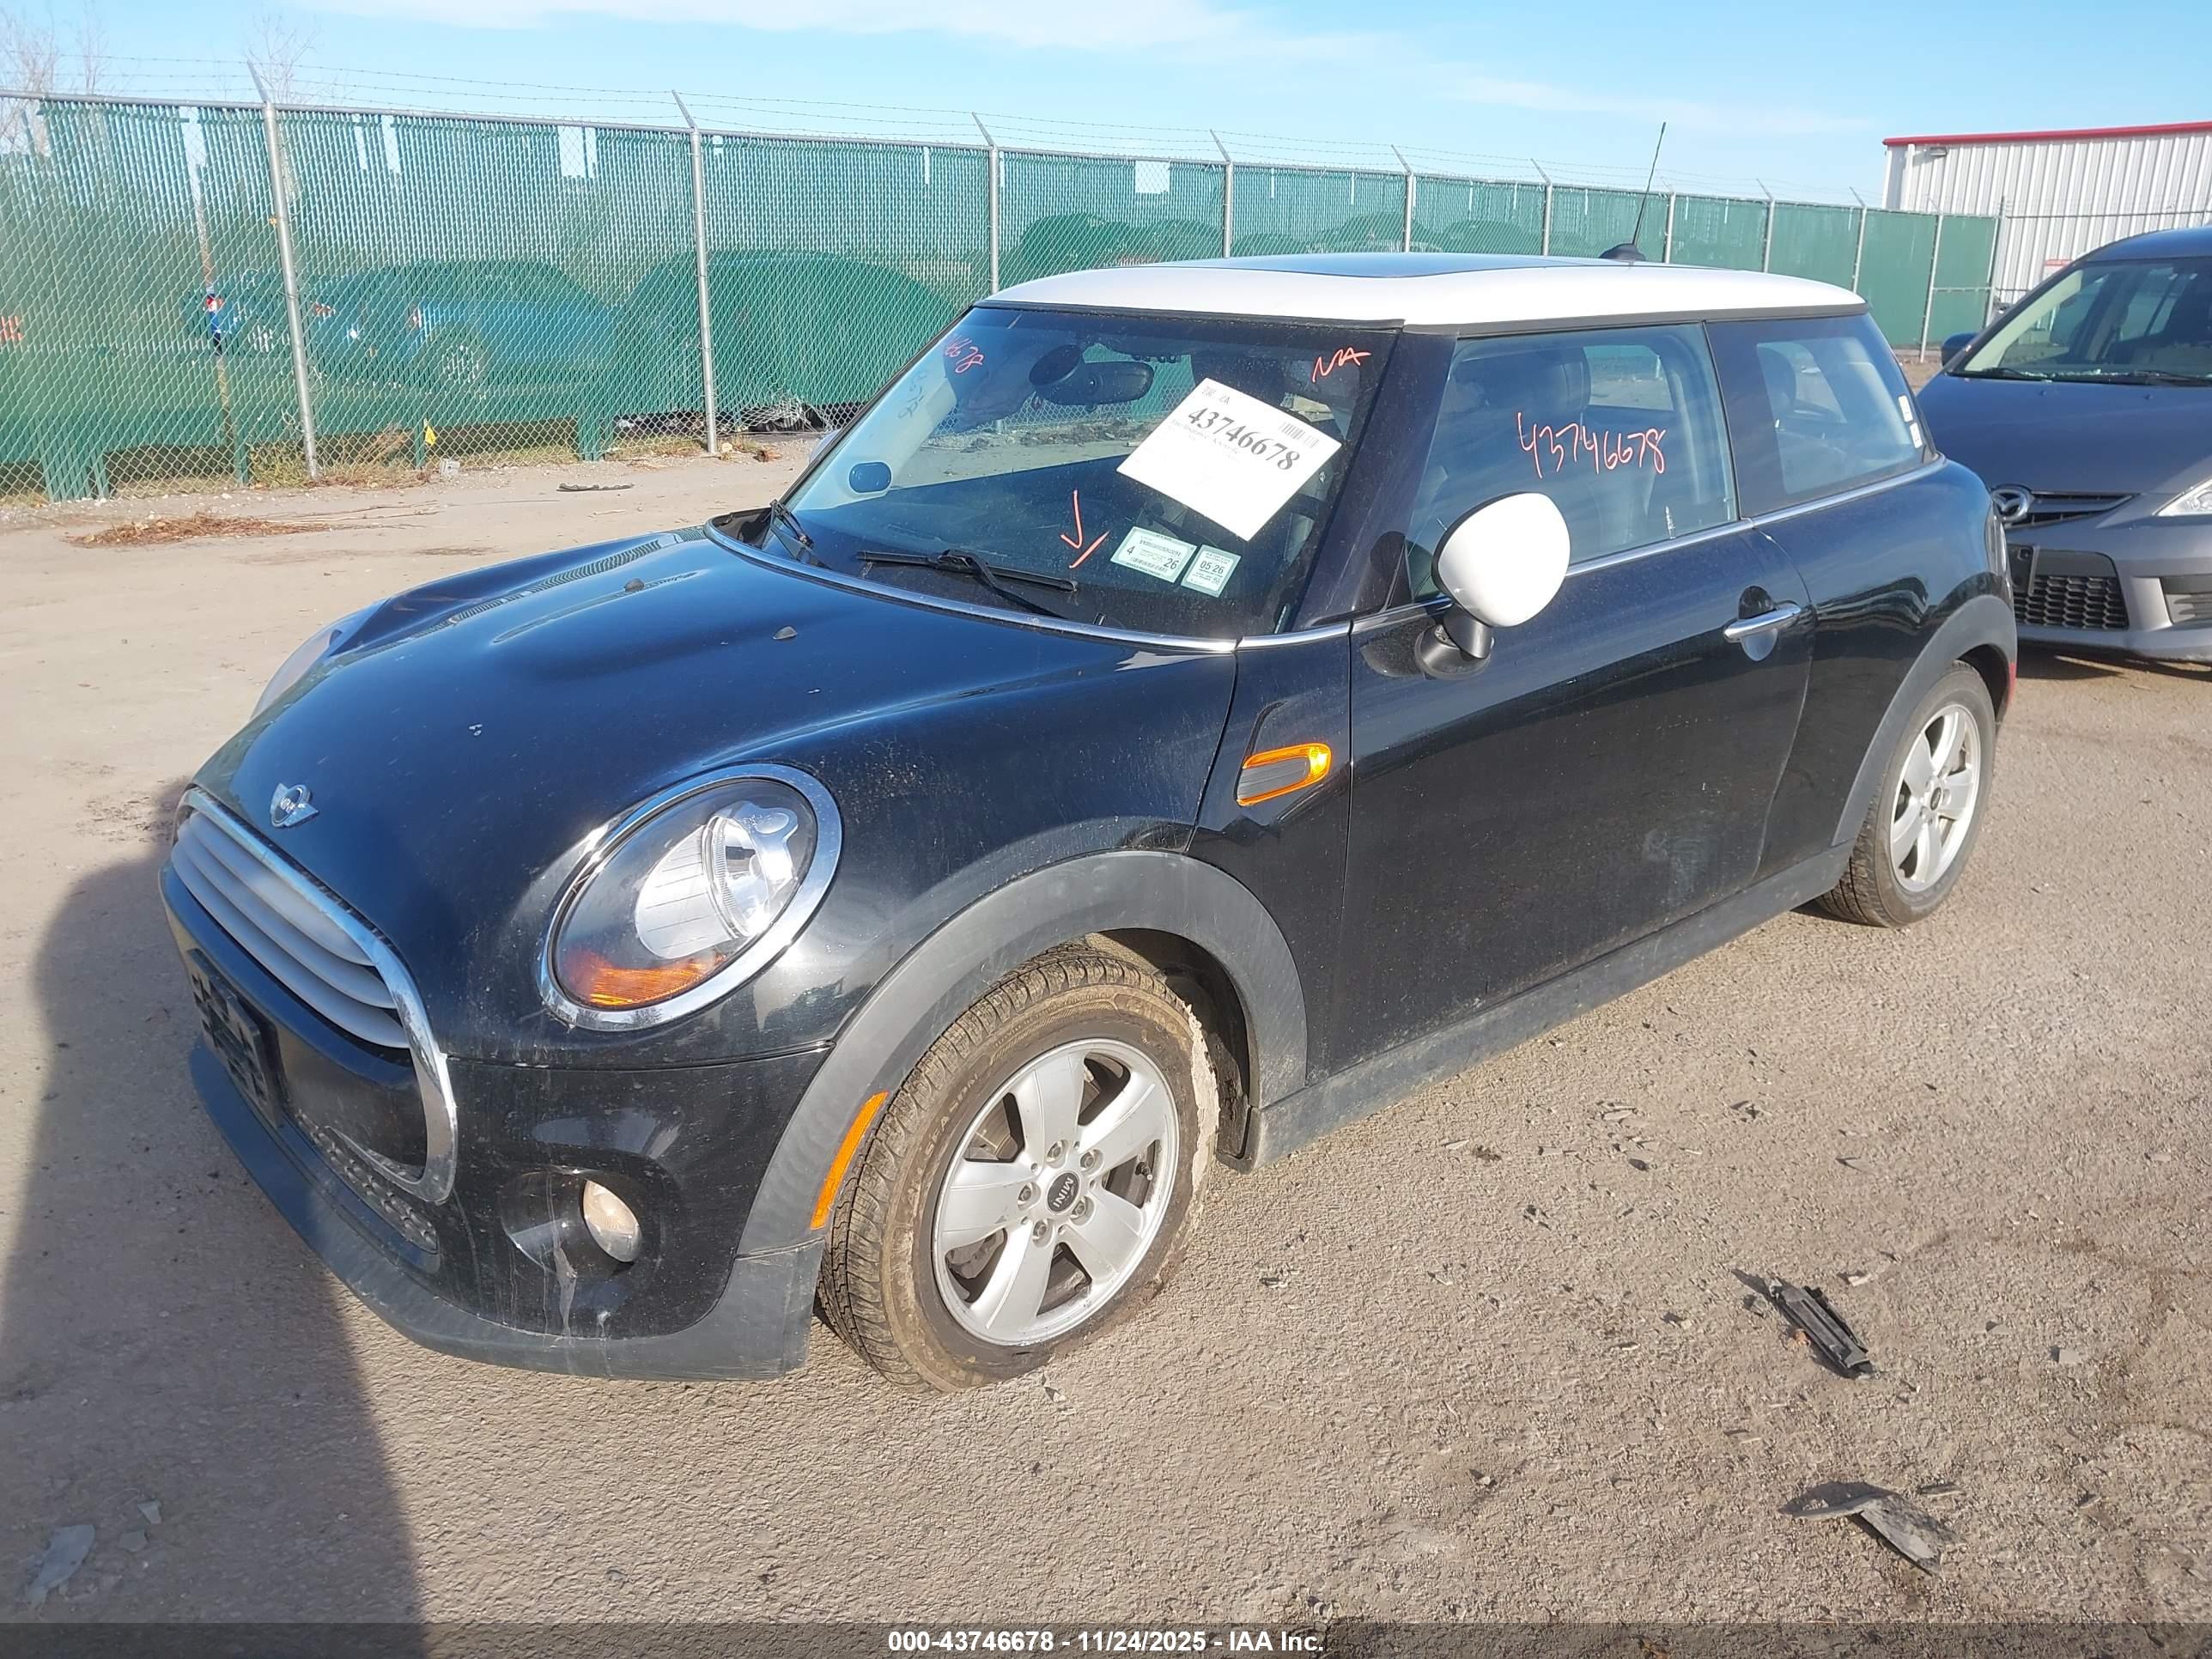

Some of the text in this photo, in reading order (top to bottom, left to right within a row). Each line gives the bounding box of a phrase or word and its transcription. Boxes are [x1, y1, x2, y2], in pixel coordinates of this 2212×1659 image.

[1188, 407, 1300, 470] 43746678
[1517, 412, 1667, 479] 43746678
[1164, 557, 1179, 569] 26
[1053, 1176, 1074, 1208] MINI
